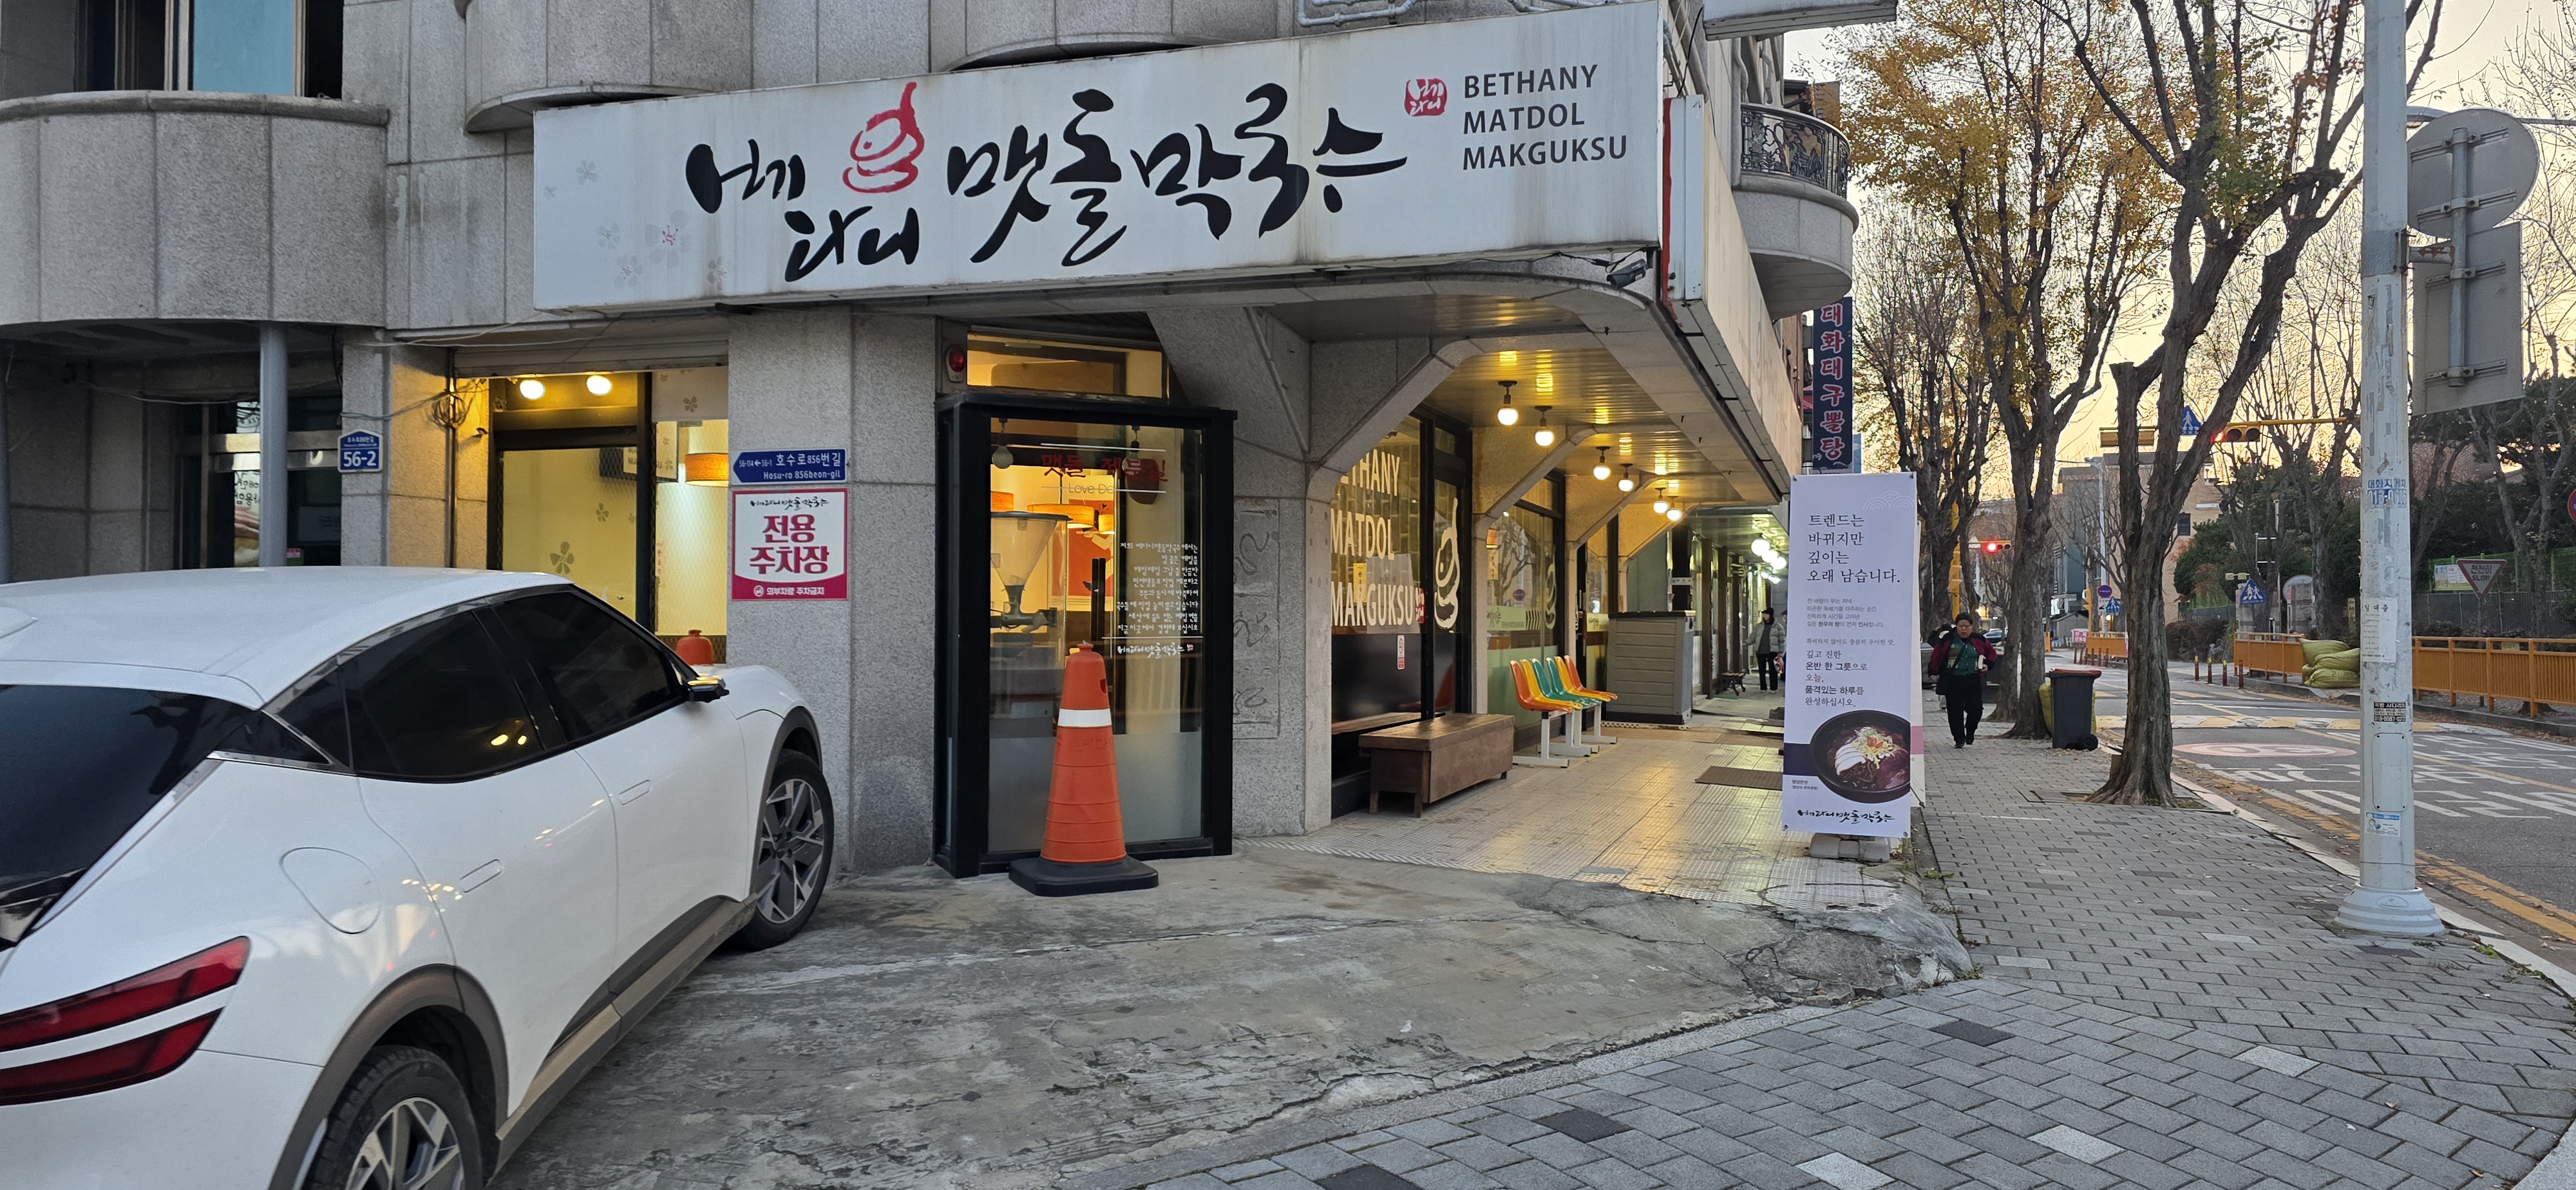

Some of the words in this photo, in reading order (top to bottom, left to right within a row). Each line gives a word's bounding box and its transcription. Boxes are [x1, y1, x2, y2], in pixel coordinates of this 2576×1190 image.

[1464, 64, 1598, 99] BETHANY
[1464, 103, 1585, 134] MATDOL
[1463, 135, 1627, 170] MAKGUKSU
[1821, 303, 1845, 460] 대화대구뽈탕
[343, 451, 376, 467] 56-2
[776, 453, 840, 467] 호수로856번길
[1041, 455, 1086, 477] 맷돌
[764, 471, 792, 480] Hosu-ro
[795, 470, 840, 479] 856beon-gil
[1069, 483, 1095, 493] Love
[1808, 514, 1864, 527] 트렌드는
[762, 514, 815, 543] 전용
[1331, 508, 1394, 560] MATDOL
[1808, 533, 1864, 546] 바뀌지만
[750, 545, 829, 574] 주차장
[1181, 556, 1198, 565] 메밀을
[1808, 551, 1850, 564] 깊이는
[1162, 578, 1173, 587] 직접
[1177, 578, 1198, 587] 제분하고
[1807, 570, 1833, 583] 오래
[1841, 569, 1900, 583] 남습니다.
[797, 587, 824, 595] 주차금지
[1156, 590, 1174, 599] 동시에
[1176, 590, 1198, 599] 반죽하여
[1139, 601, 1150, 611] 직접
[1176, 601, 1198, 611] 있습니다
[1331, 582, 1413, 626] MAKGUKSU
[1128, 612, 1150, 623] 세상에
[1117, 624, 1128, 634] 지금
[1826, 650, 1841, 659] 진한
[1806, 662, 1821, 670] 온반
[1824, 662, 1832, 670] 한
[1835, 663, 1868, 671] 그릇으로
[1805, 686, 1837, 694] 품격있는
[1840, 686, 1864, 695] 하루를
[1804, 697, 1855, 707] 완성하십시오.
